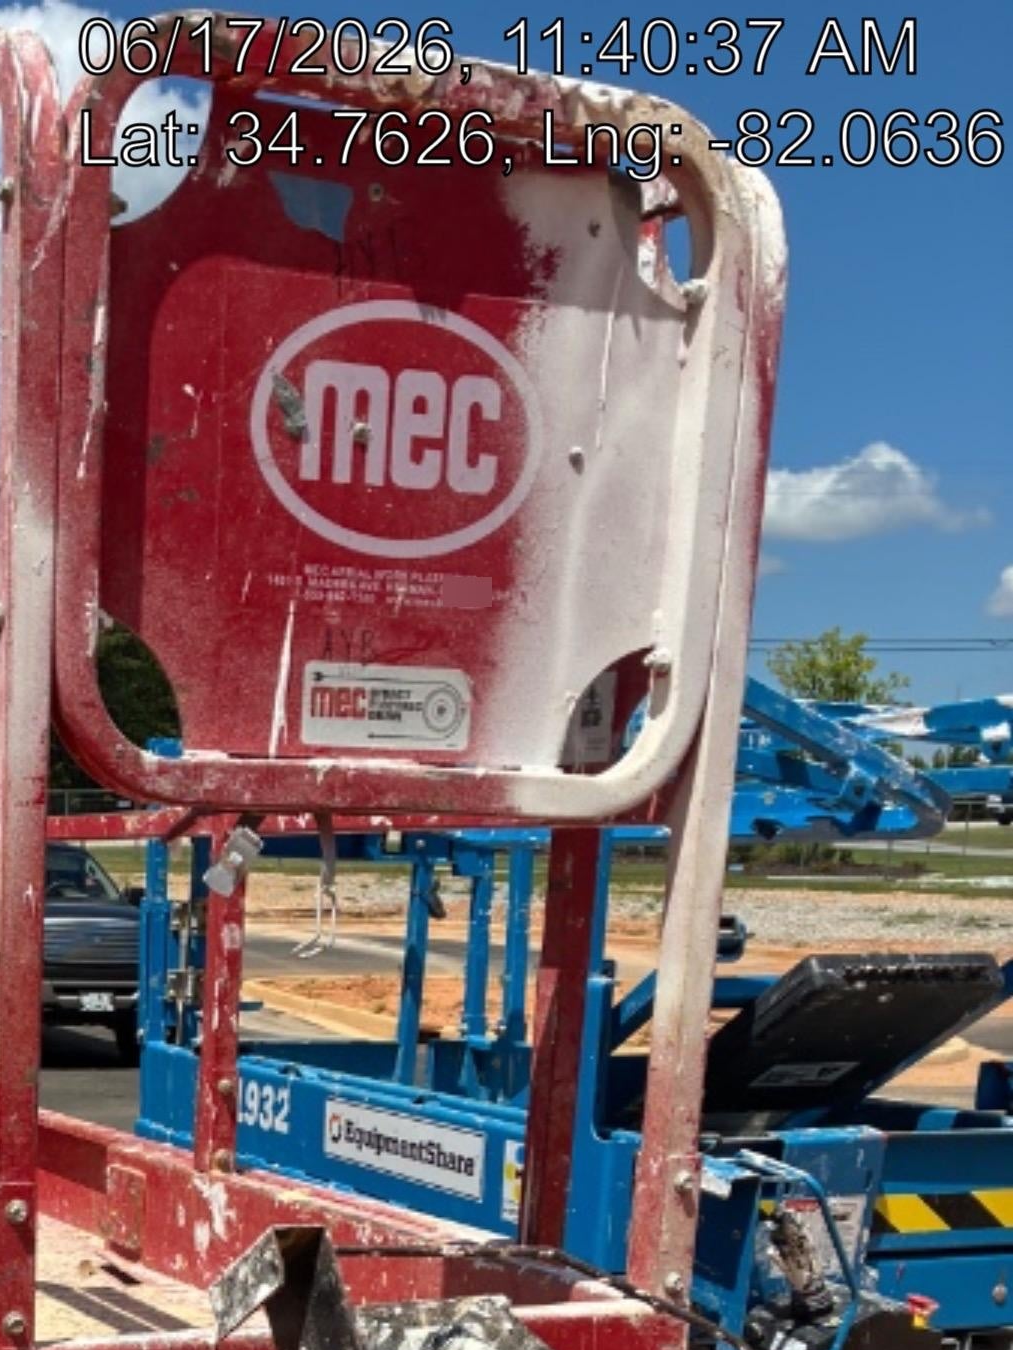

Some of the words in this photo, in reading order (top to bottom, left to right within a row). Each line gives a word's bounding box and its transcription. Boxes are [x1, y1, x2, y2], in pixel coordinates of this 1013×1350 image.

[299, 358, 502, 496] mec
[311, 686, 366, 719] mec
[344, 1119, 474, 1177] EquipmentShare
